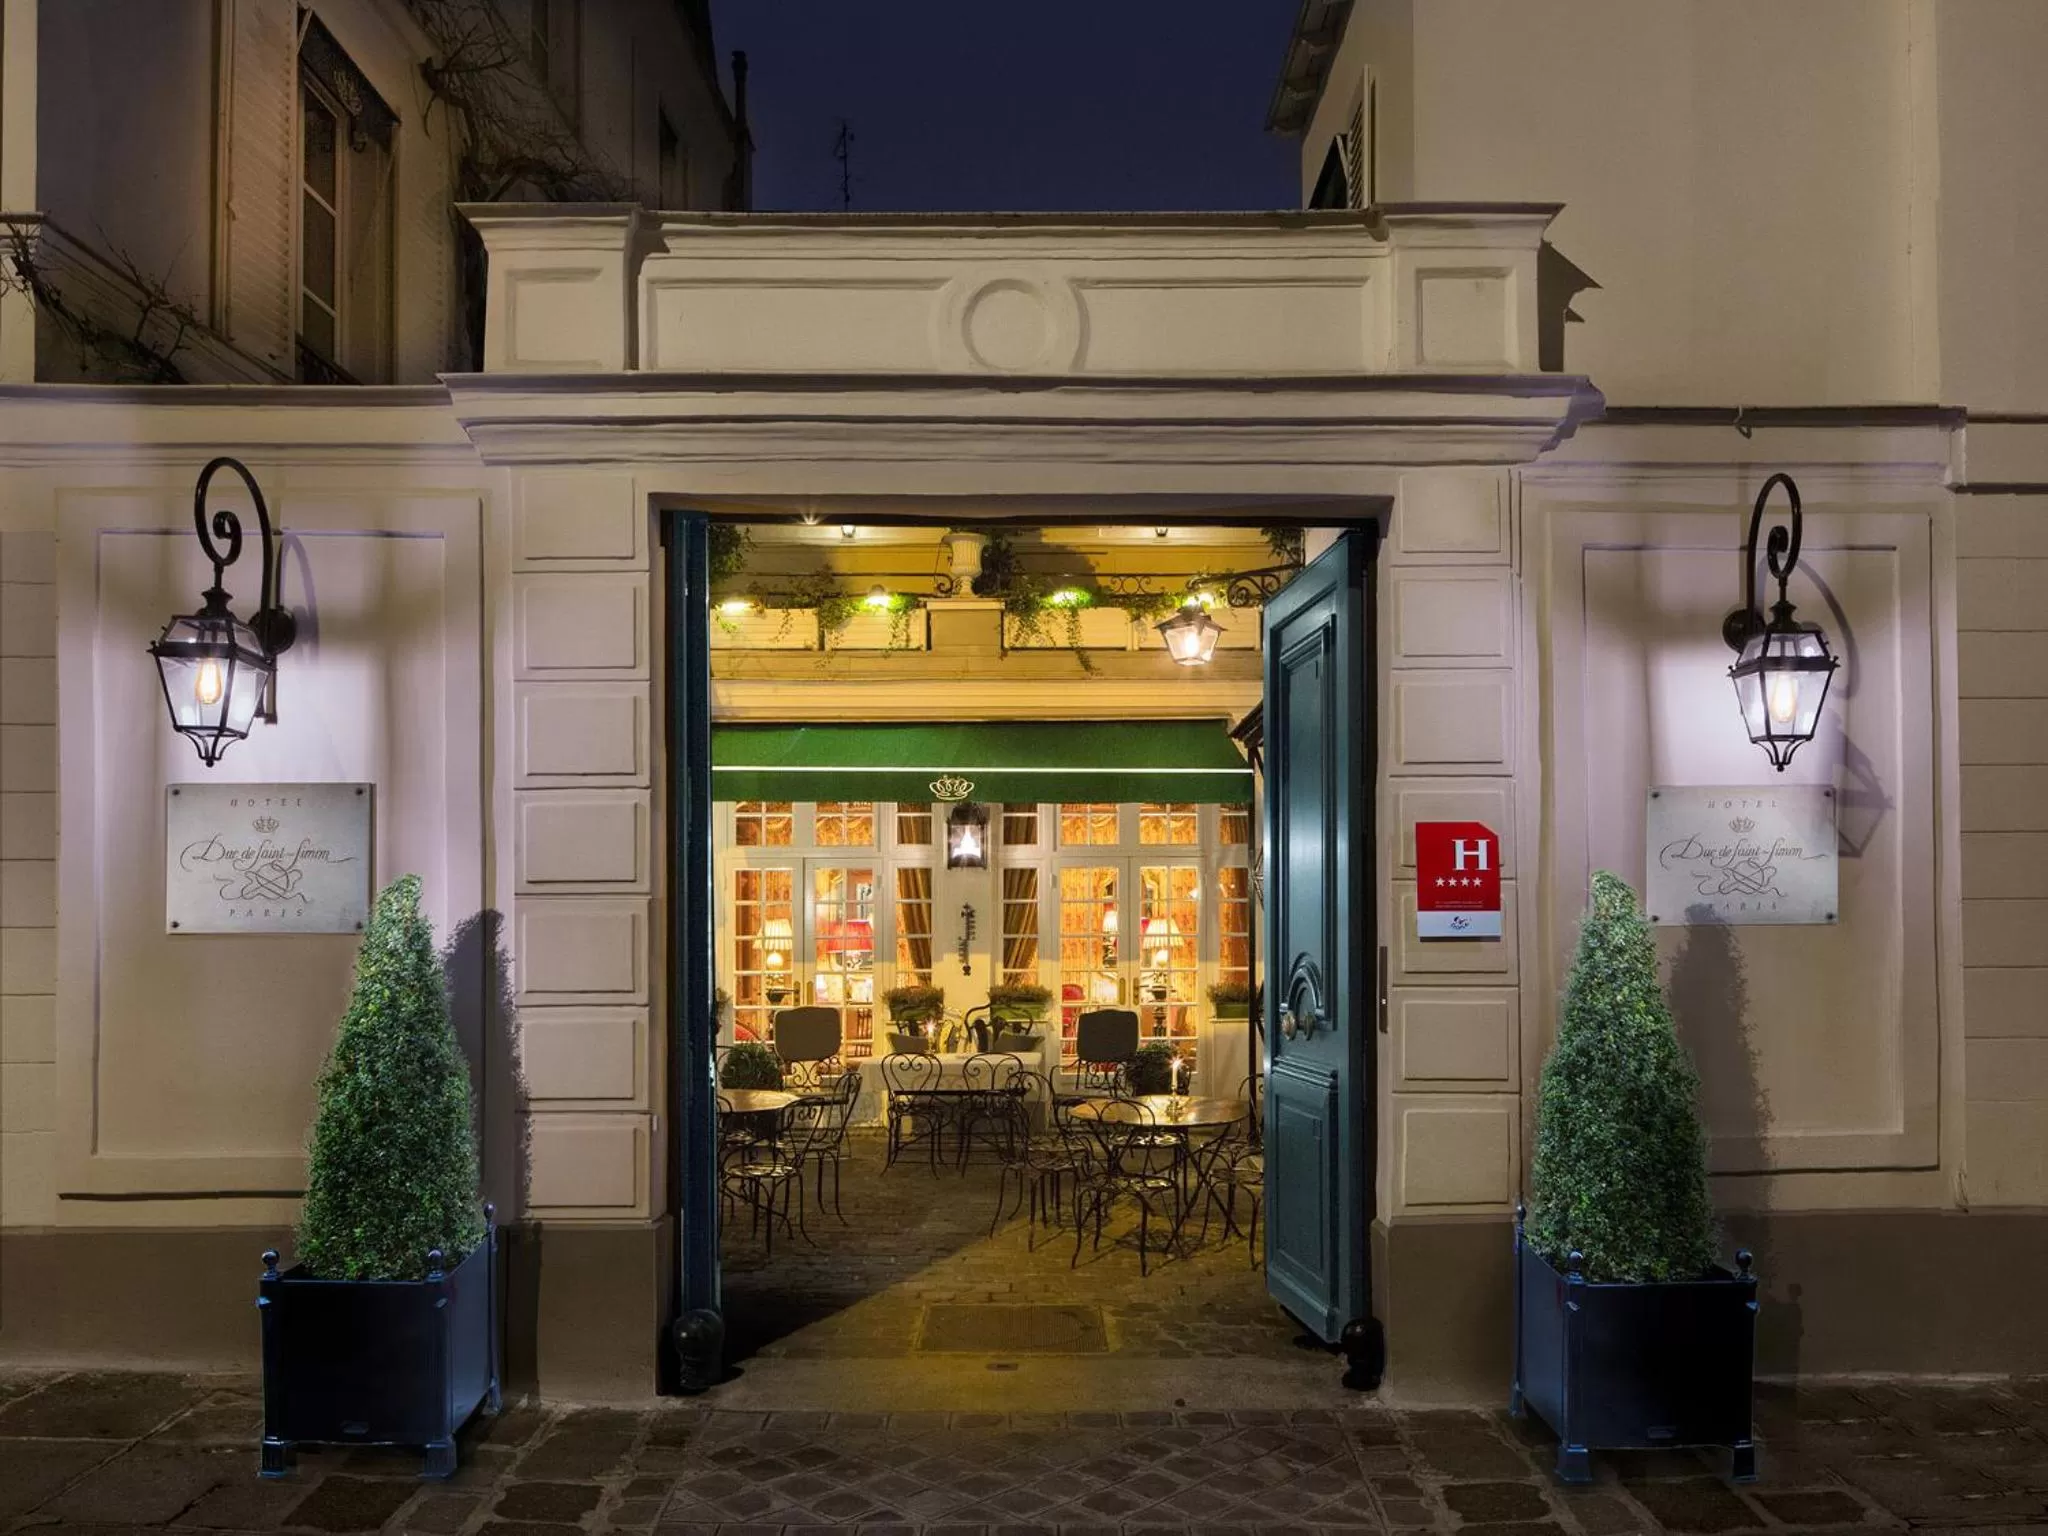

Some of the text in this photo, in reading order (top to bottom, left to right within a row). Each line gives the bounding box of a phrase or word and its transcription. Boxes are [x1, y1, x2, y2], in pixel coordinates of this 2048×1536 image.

[230, 798, 302, 807] HOTEL
[1708, 800, 1778, 808] HOTEL
[180, 832, 240, 872] Duc
[241, 845, 256, 860] de
[1452, 838, 1491, 870] H
[1659, 832, 1714, 870] Duc
[1719, 845, 1731, 859] de
[230, 908, 303, 917] PARIS
